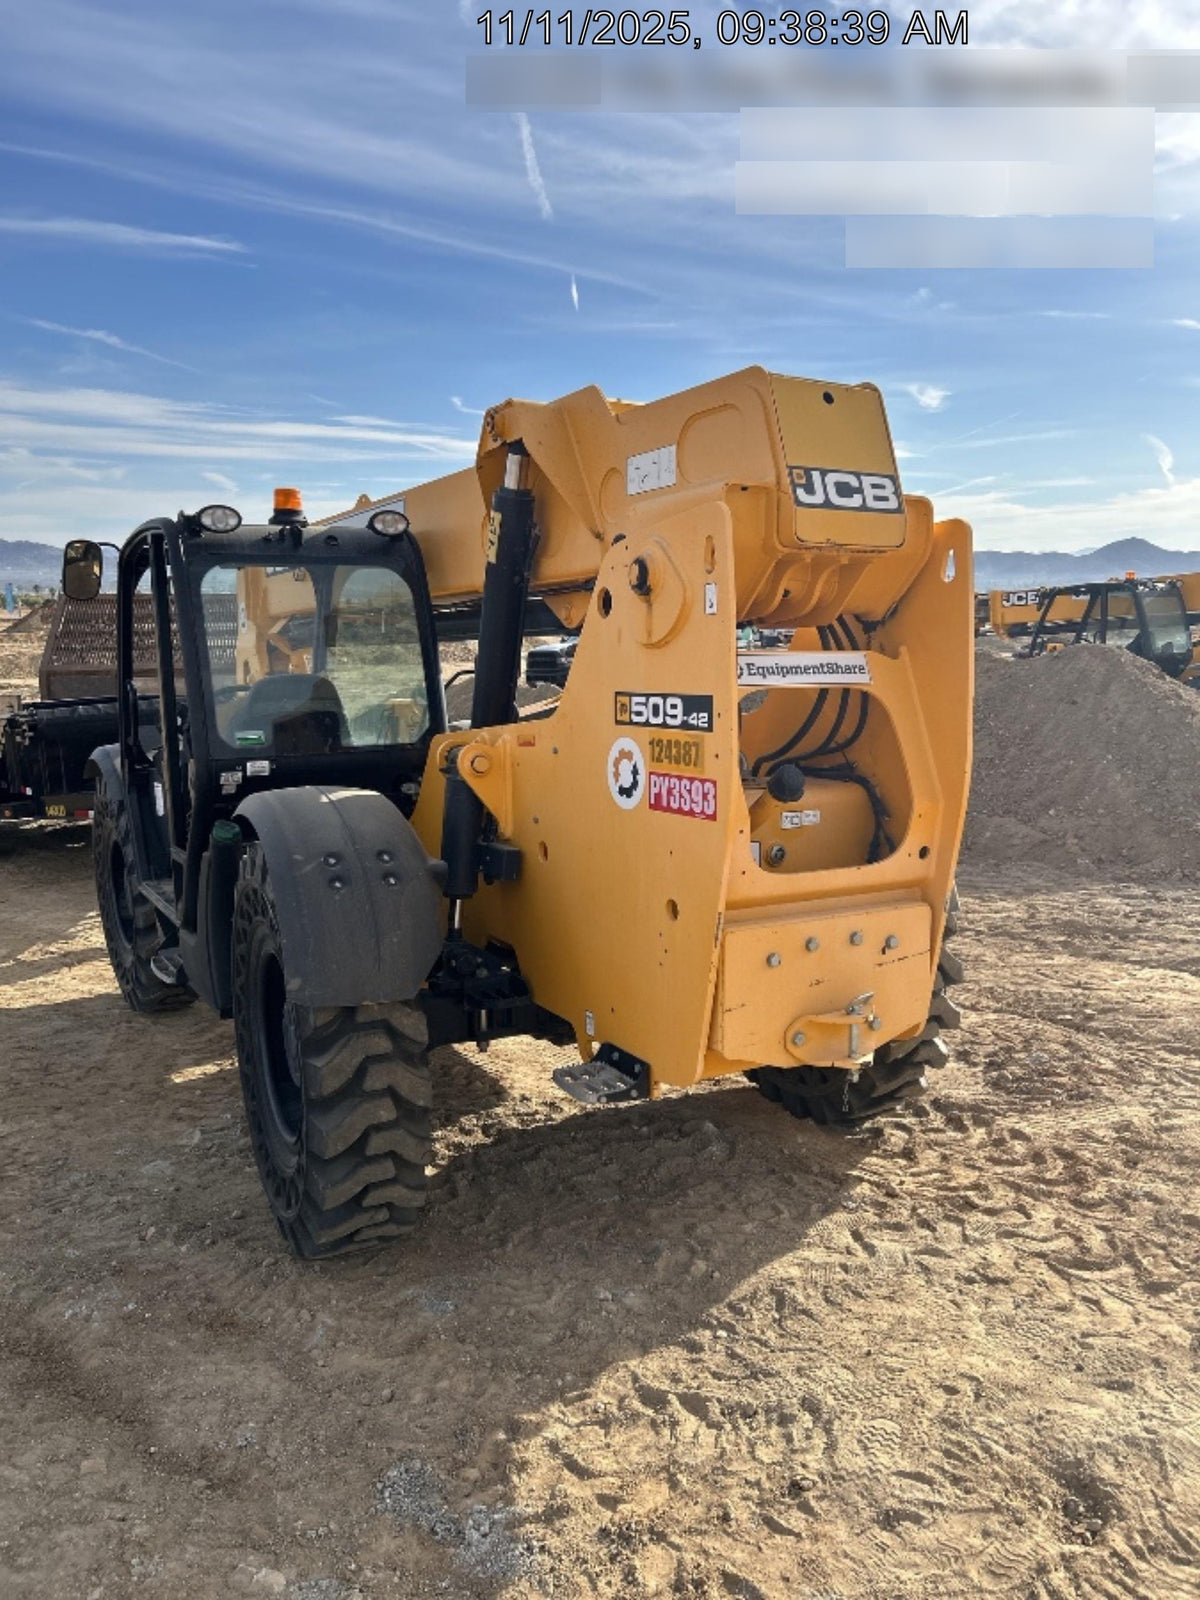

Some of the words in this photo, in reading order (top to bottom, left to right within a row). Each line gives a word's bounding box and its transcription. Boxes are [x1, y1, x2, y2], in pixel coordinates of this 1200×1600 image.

[796, 470, 899, 510] JCB
[745, 662, 866, 678] EquipmentShare
[648, 738, 700, 768] 124387
